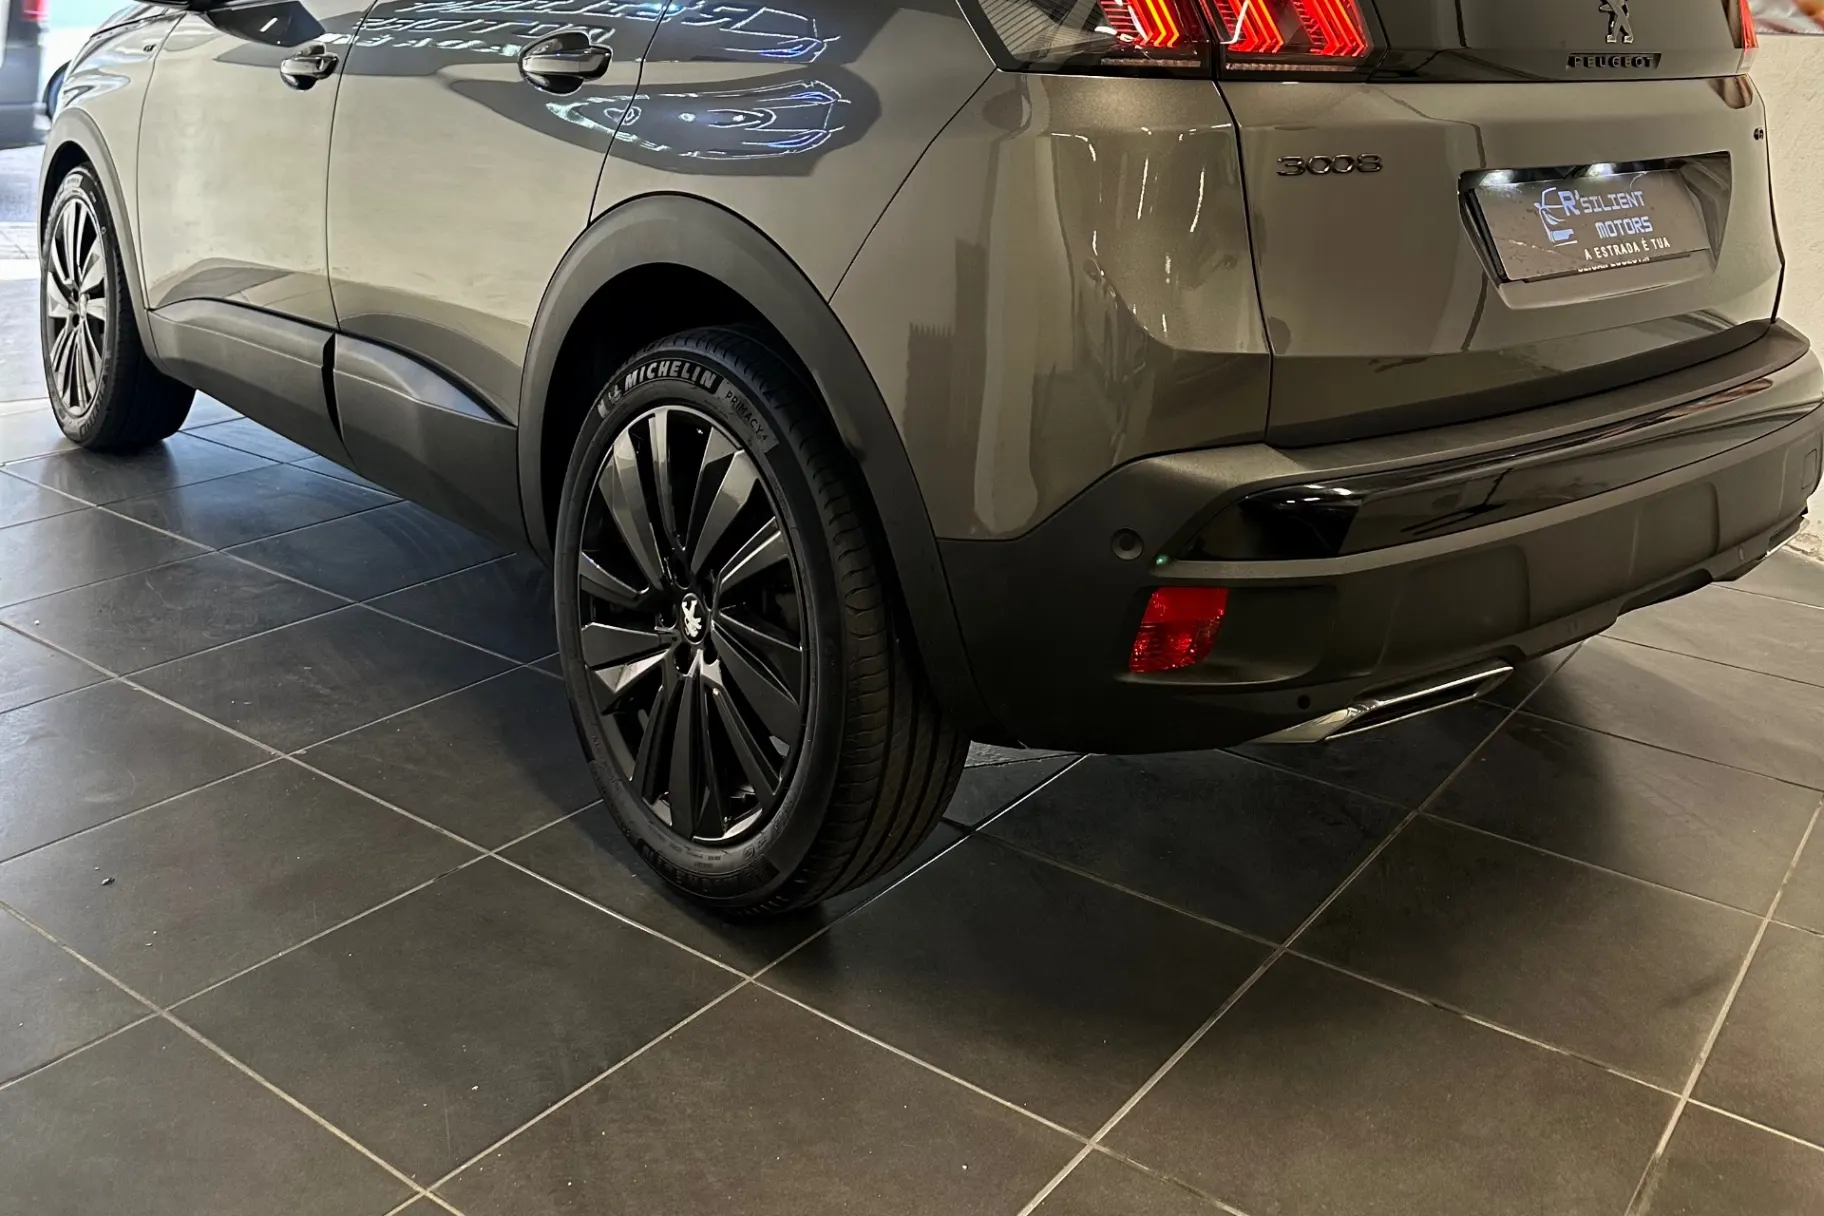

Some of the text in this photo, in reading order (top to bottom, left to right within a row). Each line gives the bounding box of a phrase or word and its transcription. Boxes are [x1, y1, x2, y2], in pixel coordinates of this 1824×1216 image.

[1570, 55, 1654, 69] PEUGEOT
[1276, 152, 1383, 176] 3008
[1557, 189, 1646, 217] R'SILIENT
[1595, 215, 1653, 240] MOTORS
[1584, 237, 1671, 261] A ESTRADA É TUA
[624, 360, 717, 391] MICHELIN
[725, 390, 765, 435] PRIMACY
